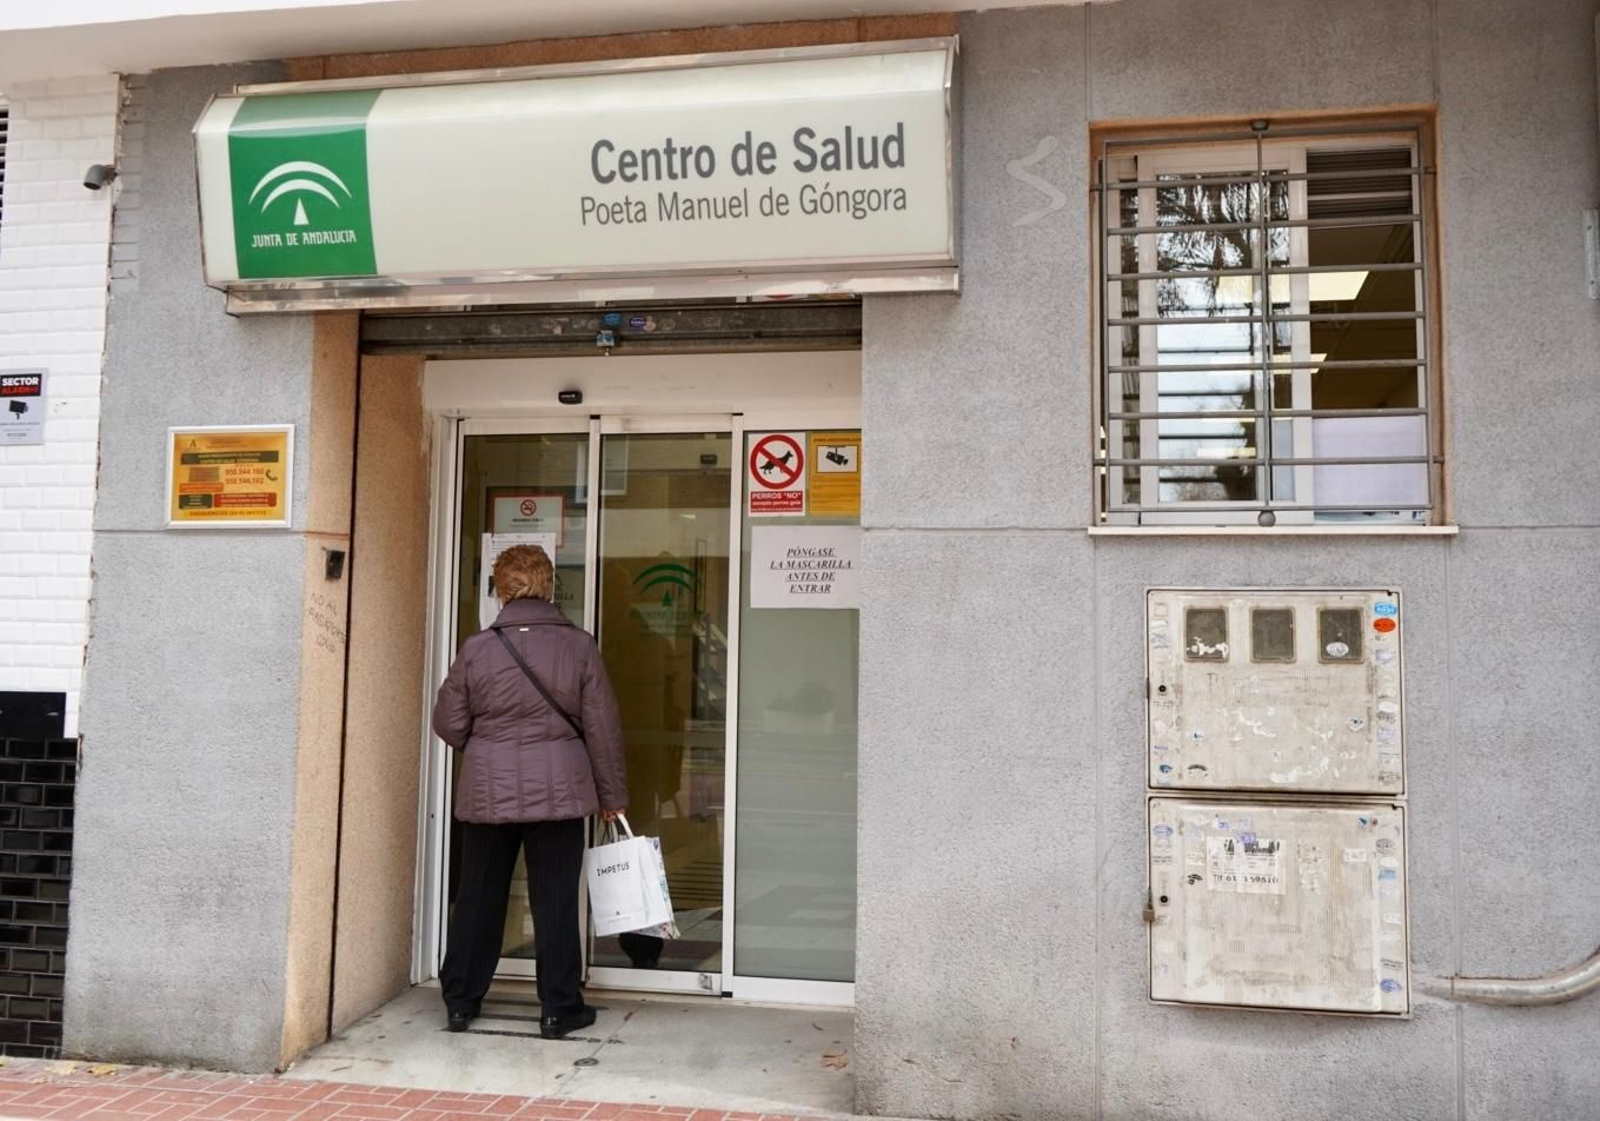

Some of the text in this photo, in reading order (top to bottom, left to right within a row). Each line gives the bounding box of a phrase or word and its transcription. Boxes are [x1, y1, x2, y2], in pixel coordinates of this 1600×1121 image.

[590, 121, 905, 185] Centro de Salud
[580, 181, 907, 226] Poeta Manuel de Góngora
[251, 229, 357, 248] JUNTA DE ANDALUCIA
[2, 377, 39, 386] SECTOR
[752, 492, 782, 500] PERROS
[786, 546, 837, 557] PÓNGASE
[770, 559, 853, 570] LA MASCARILLA
[786, 571, 836, 582] ANTES DE
[789, 584, 832, 594] ENTRAR
[596, 861, 630, 876] IMPETUS
